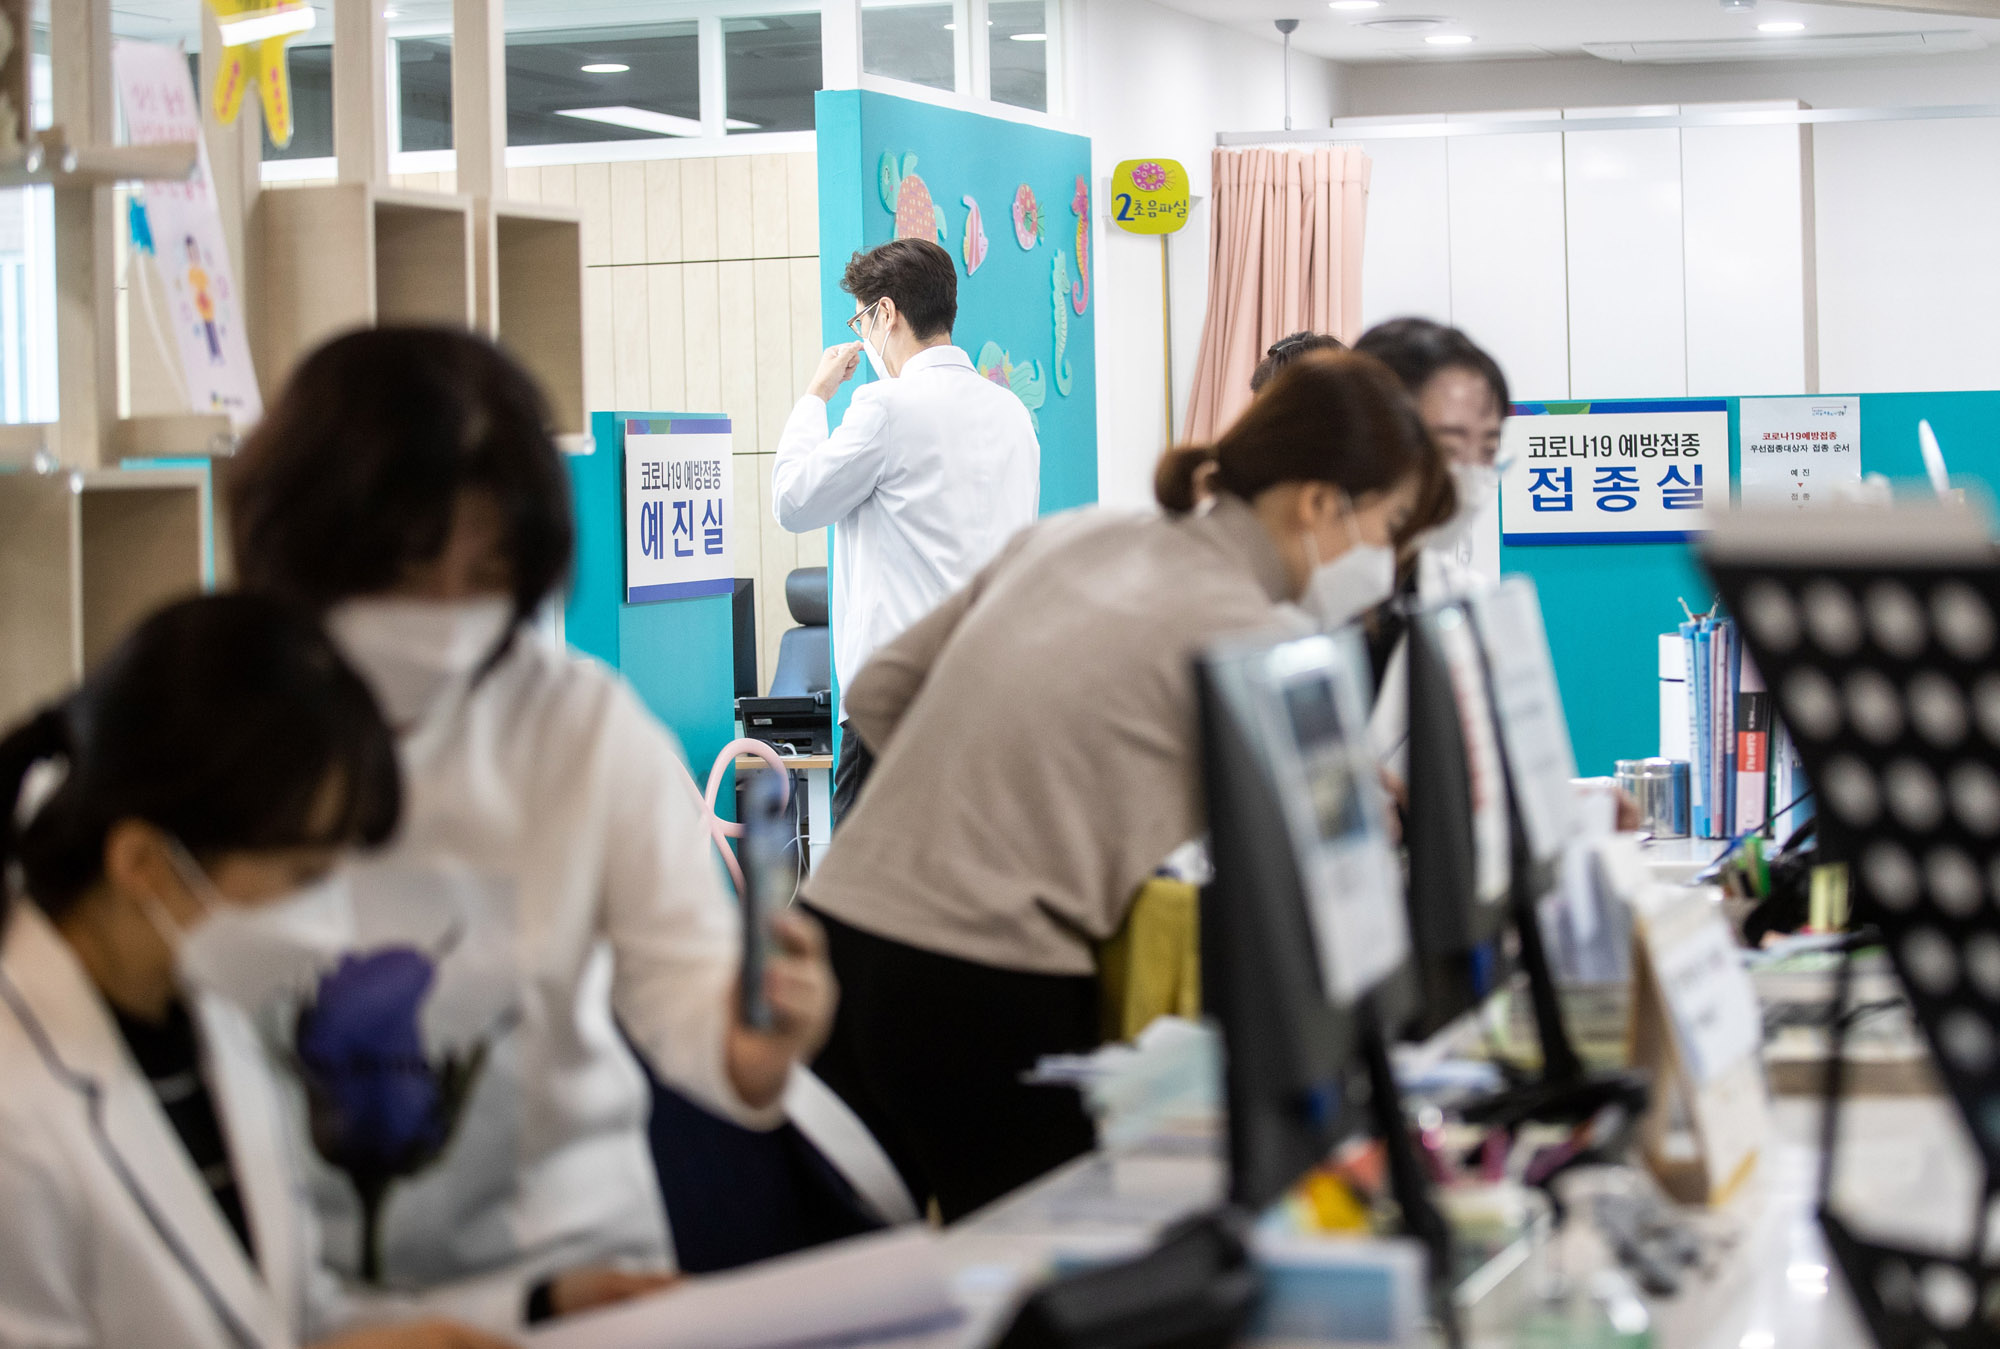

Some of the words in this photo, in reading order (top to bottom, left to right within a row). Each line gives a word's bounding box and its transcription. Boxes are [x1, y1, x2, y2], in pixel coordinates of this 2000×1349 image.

[1762, 431, 1837, 441] 코로나19예방접종
[1528, 434, 1612, 459] 코로나19
[1618, 433, 1701, 458] 예방접종
[1750, 444, 1809, 454] 우선접종대상자
[1812, 444, 1829, 453] 접종
[641, 461, 681, 491] 코로나19
[684, 460, 721, 490] 예방접종
